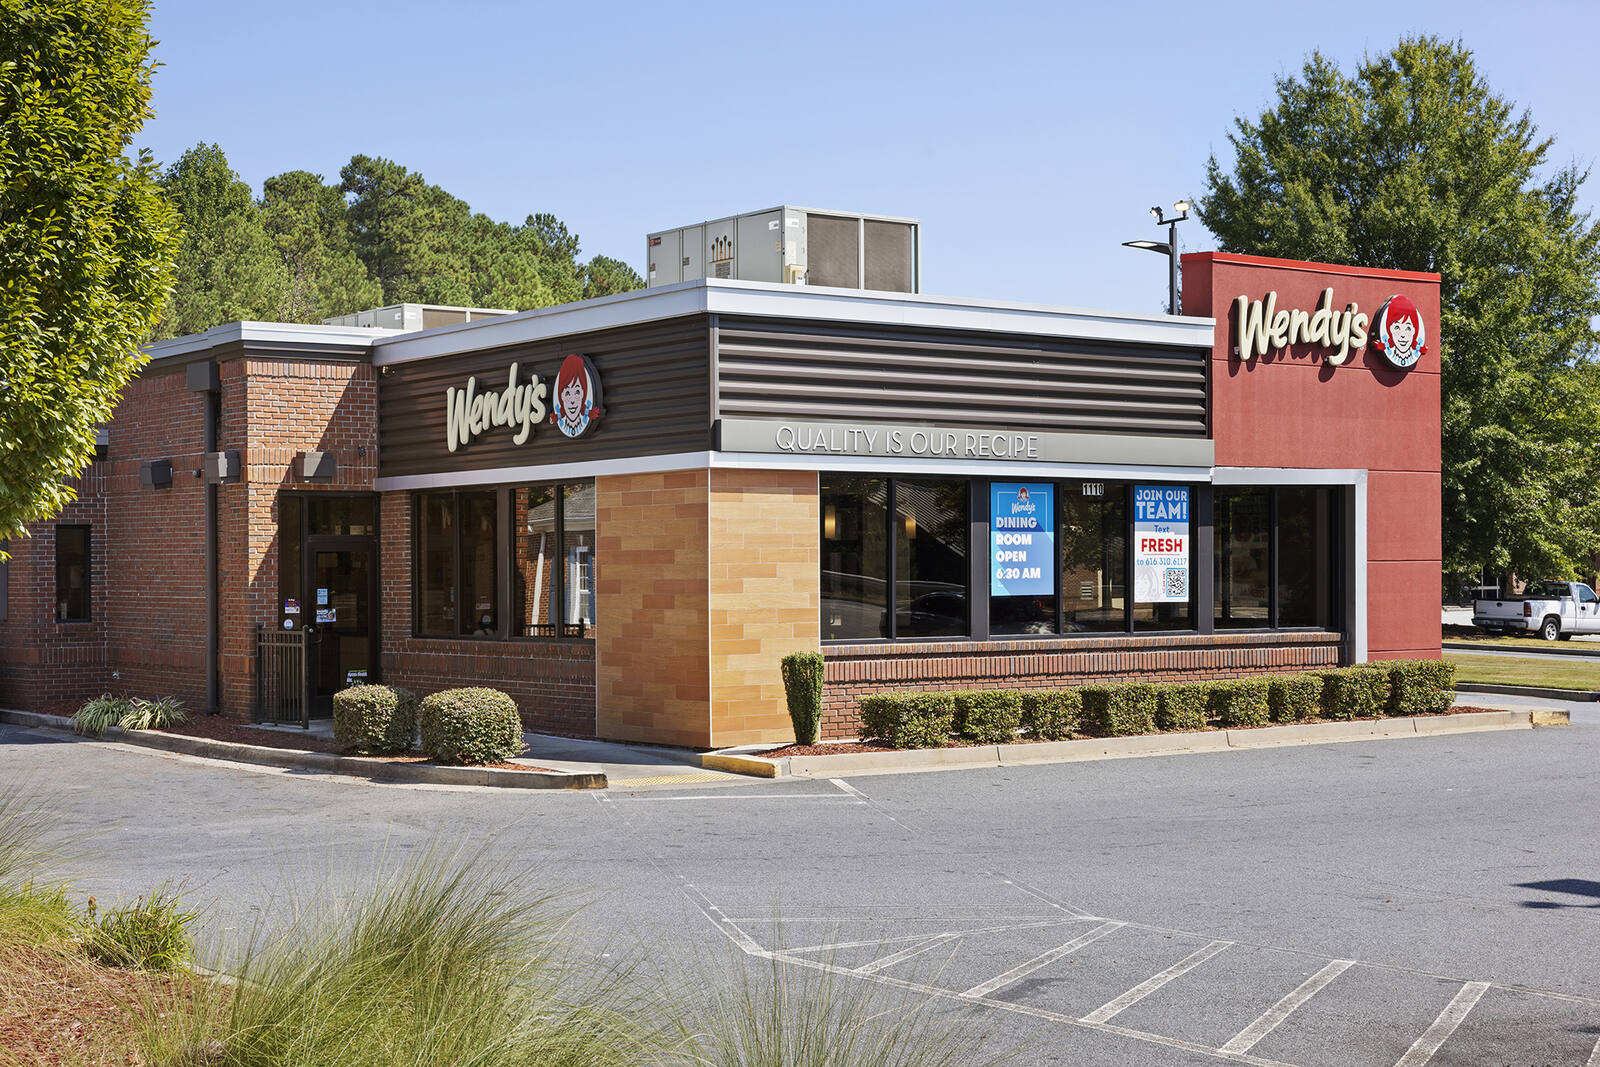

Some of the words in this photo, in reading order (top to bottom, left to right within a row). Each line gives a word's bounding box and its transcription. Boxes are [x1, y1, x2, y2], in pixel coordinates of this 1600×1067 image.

[1237, 287, 1369, 366] Wendy's
[446, 362, 547, 452] Wendy's
[775, 426, 878, 452] QUALITY
[885, 431, 903, 453] IS
[910, 431, 957, 456] OUR
[964, 434, 1039, 458] RECIPE
[1082, 482, 1104, 496] 1110
[1136, 489, 1163, 501] JOIN
[1165, 490, 1188, 502] OUR
[1011, 501, 1036, 515] Wendy's
[1136, 501, 1188, 520] TEAM!
[996, 516, 1038, 529] DINING
[1153, 524, 1170, 533] Text
[996, 533, 1033, 546] ROOM
[1141, 538, 1183, 553] FRESH
[996, 550, 1027, 563] OPEN
[1136, 558, 1145, 566] to
[1145, 557, 1187, 567] 616.310.6117
[1022, 567, 1041, 579] AM
